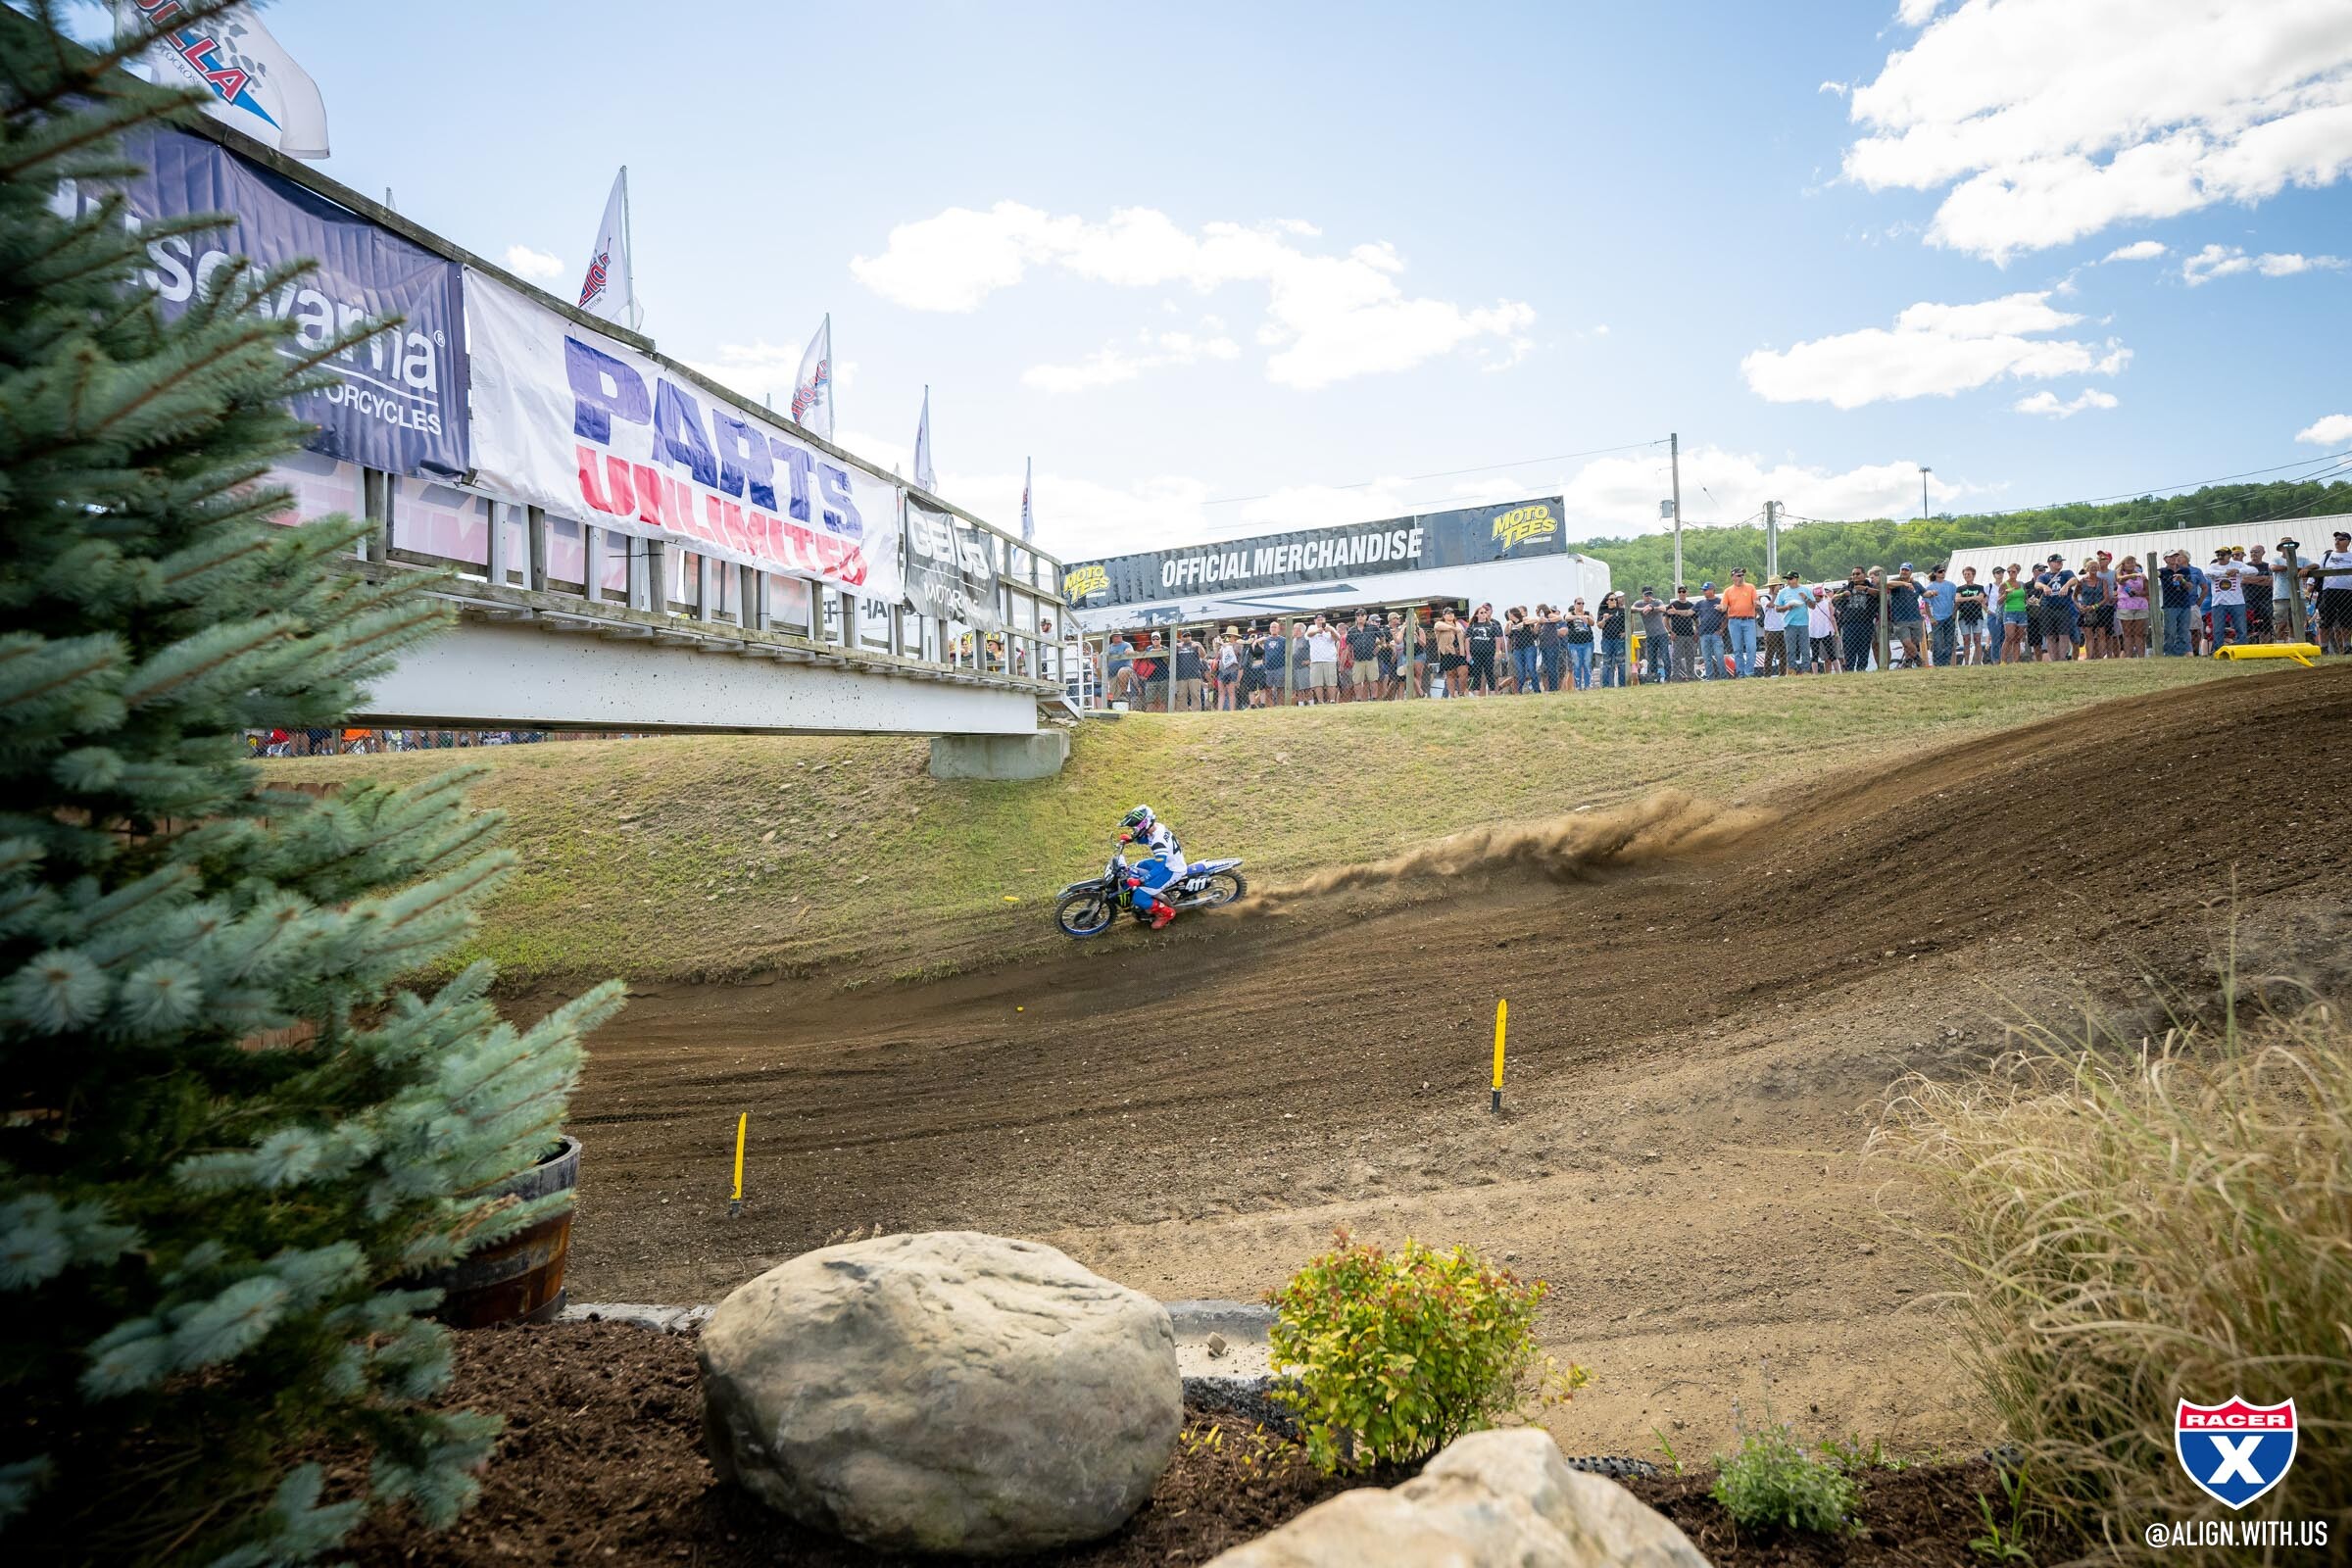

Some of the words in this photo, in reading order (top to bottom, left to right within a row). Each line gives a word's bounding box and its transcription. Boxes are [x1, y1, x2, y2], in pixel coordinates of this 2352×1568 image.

[153, 37, 203, 88] OTOCROSS
[564, 334, 863, 540] PARTS
[576, 443, 868, 587] UNLIMITED
[1492, 505, 1549, 541] MOTO
[1502, 516, 1557, 552] TEES
[1161, 552, 1252, 588] OFFICIAL
[1252, 528, 1425, 576] MERCHANDISE
[1063, 565, 1104, 595] MOTO
[1070, 575, 1110, 605] TEES
[1185, 877, 1207, 892] 411
